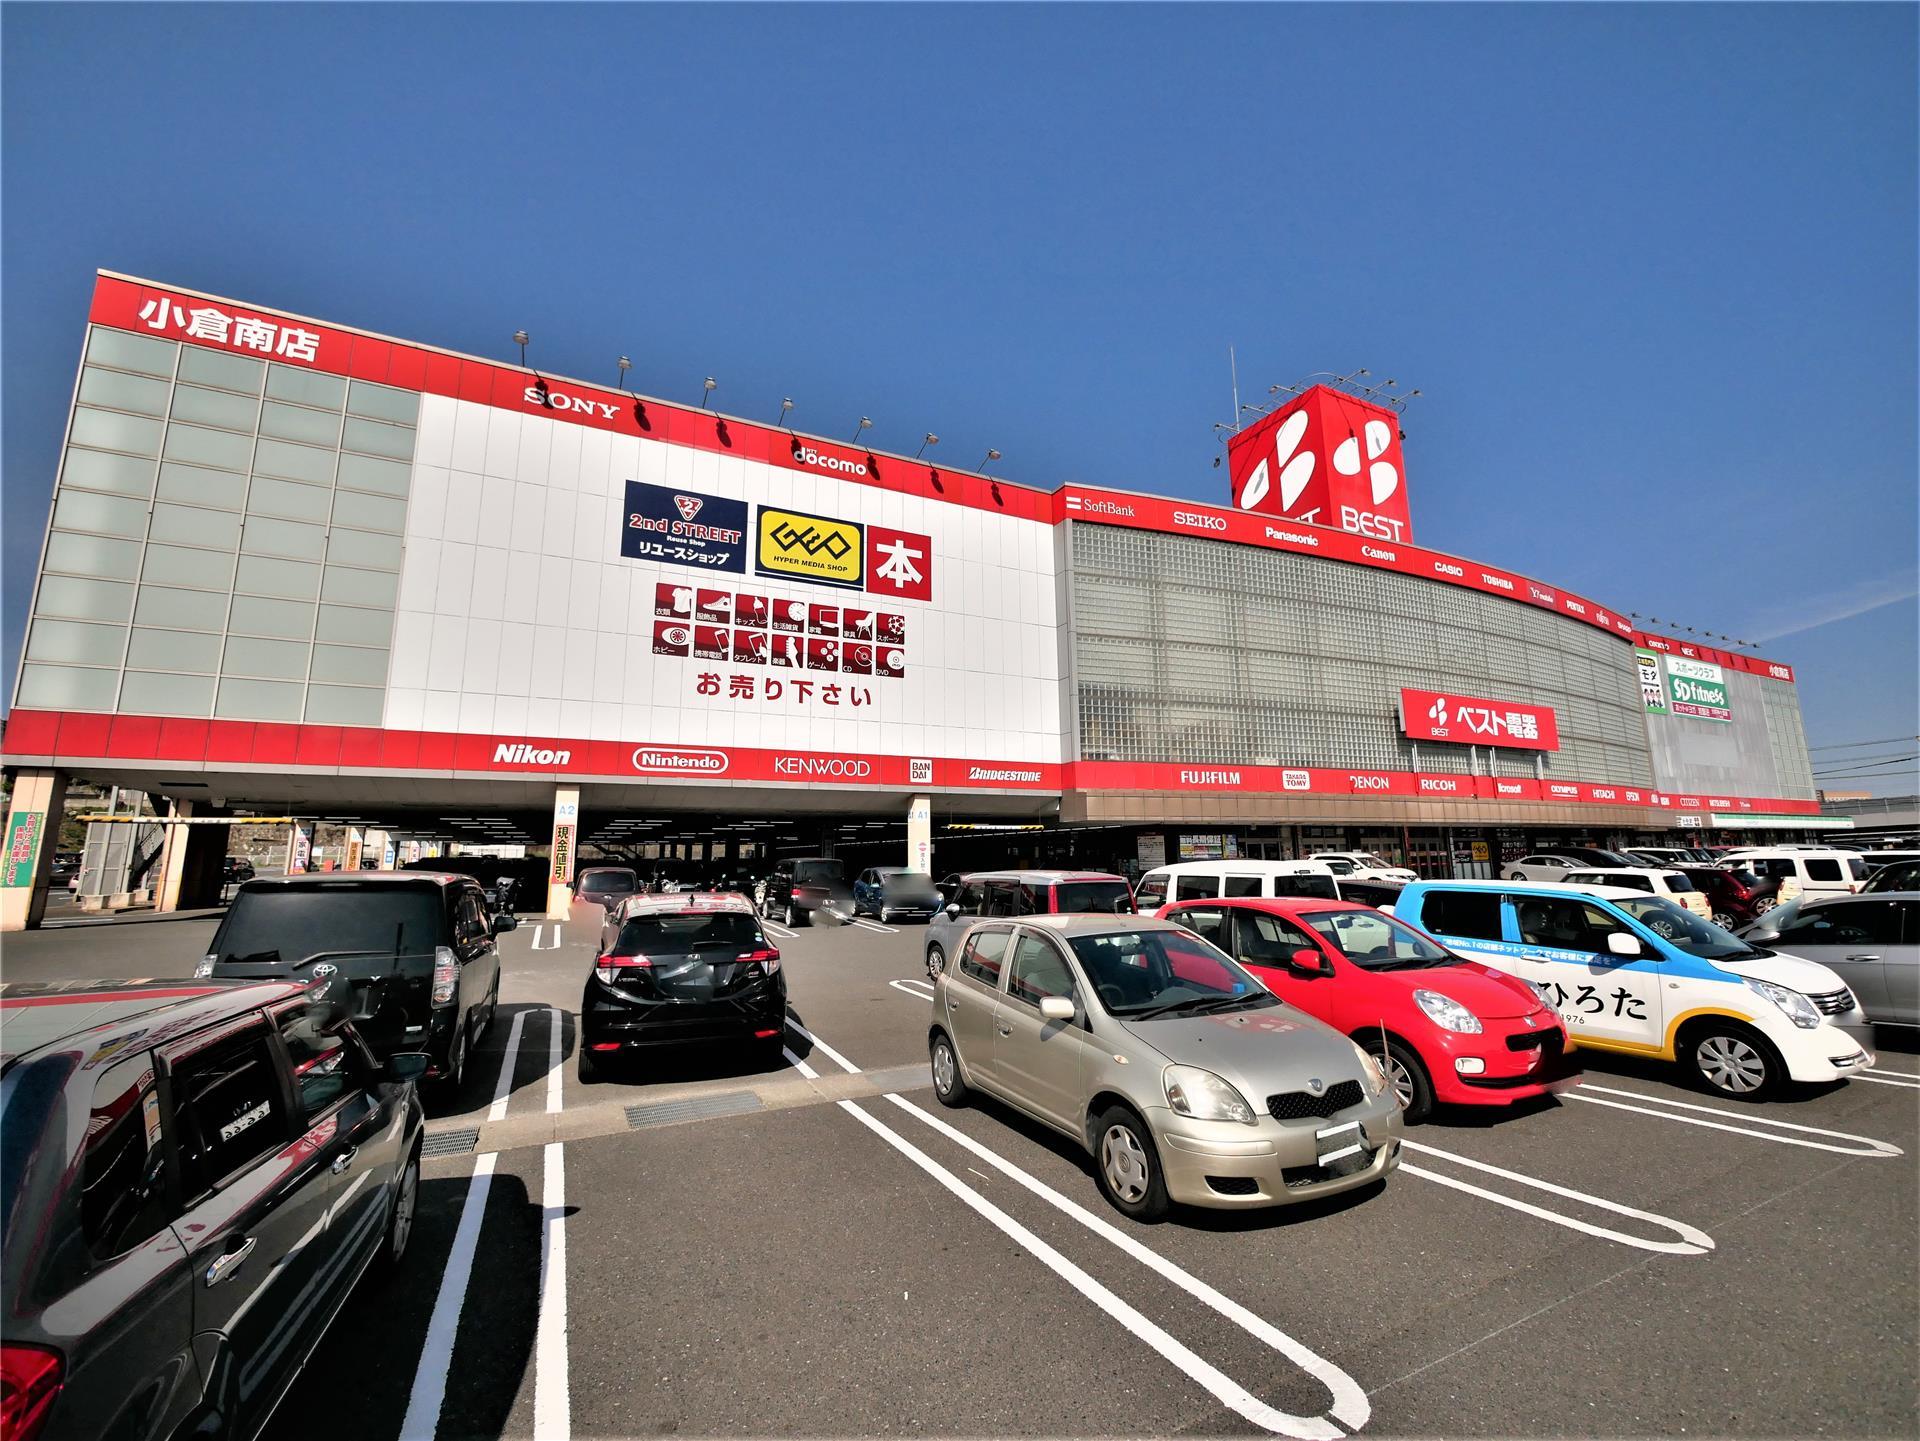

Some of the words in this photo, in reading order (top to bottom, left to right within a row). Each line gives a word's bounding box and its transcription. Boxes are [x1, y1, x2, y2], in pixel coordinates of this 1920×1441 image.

[139, 297, 320, 362] 小倉南店
[524, 387, 620, 419] SONY
[794, 447, 867, 476] docomo
[1084, 499, 1135, 517] SoftBank
[1173, 511, 1227, 531] SEIKO
[1341, 505, 1403, 542] BEST
[629, 514, 668, 533] 2nd
[672, 521, 742, 545] STREET
[1265, 527, 1319, 547] Panasonic
[689, 539, 706, 547] Shop
[770, 522, 852, 560] GEO
[640, 541, 730, 565] リユースショップ
[1361, 545, 1396, 562] Canon
[773, 555, 800, 565] HYPER
[801, 560, 825, 569] MEDIA
[827, 563, 848, 572] SHOP
[876, 540, 923, 589] 本
[1434, 561, 1463, 577] CASIO
[1482, 574, 1513, 591] TOSHIBA
[656, 608, 671, 616] 衣類
[735, 618, 756, 626] キッズ
[773, 622, 799, 631] 生活雑貨
[843, 630, 856, 638] 家具
[877, 635, 900, 643] スポーツ
[653, 646, 675, 654] ホビー
[694, 649, 723, 660] 携帯電話
[1681, 647, 1694, 657] NEC
[734, 654, 763, 664] タブレット
[808, 661, 827, 670] ゲーム
[697, 672, 872, 707] お売り下さい
[1456, 705, 1539, 740] ベスト電器
[1431, 727, 1449, 737] BEST
[493, 743, 571, 765] Nikon
[641, 752, 720, 769] Nintendo
[774, 756, 871, 777] KENWOOD
[912, 762, 930, 771] BAN
[912, 771, 927, 779] DAI
[968, 767, 1041, 782] BRIDGESTONE
[1181, 770, 1241, 785] FUJIFILM
[1350, 775, 1390, 789] DENON
[1286, 779, 1307, 787] TOMY
[1420, 778, 1457, 791] RICOH
[1551, 785, 1578, 795] OLYMPUS
[1592, 789, 1616, 799] HITACHI
[559, 805, 575, 815] A2
[918, 811, 927, 819] A1
[555, 827, 569, 881] 現金値引
